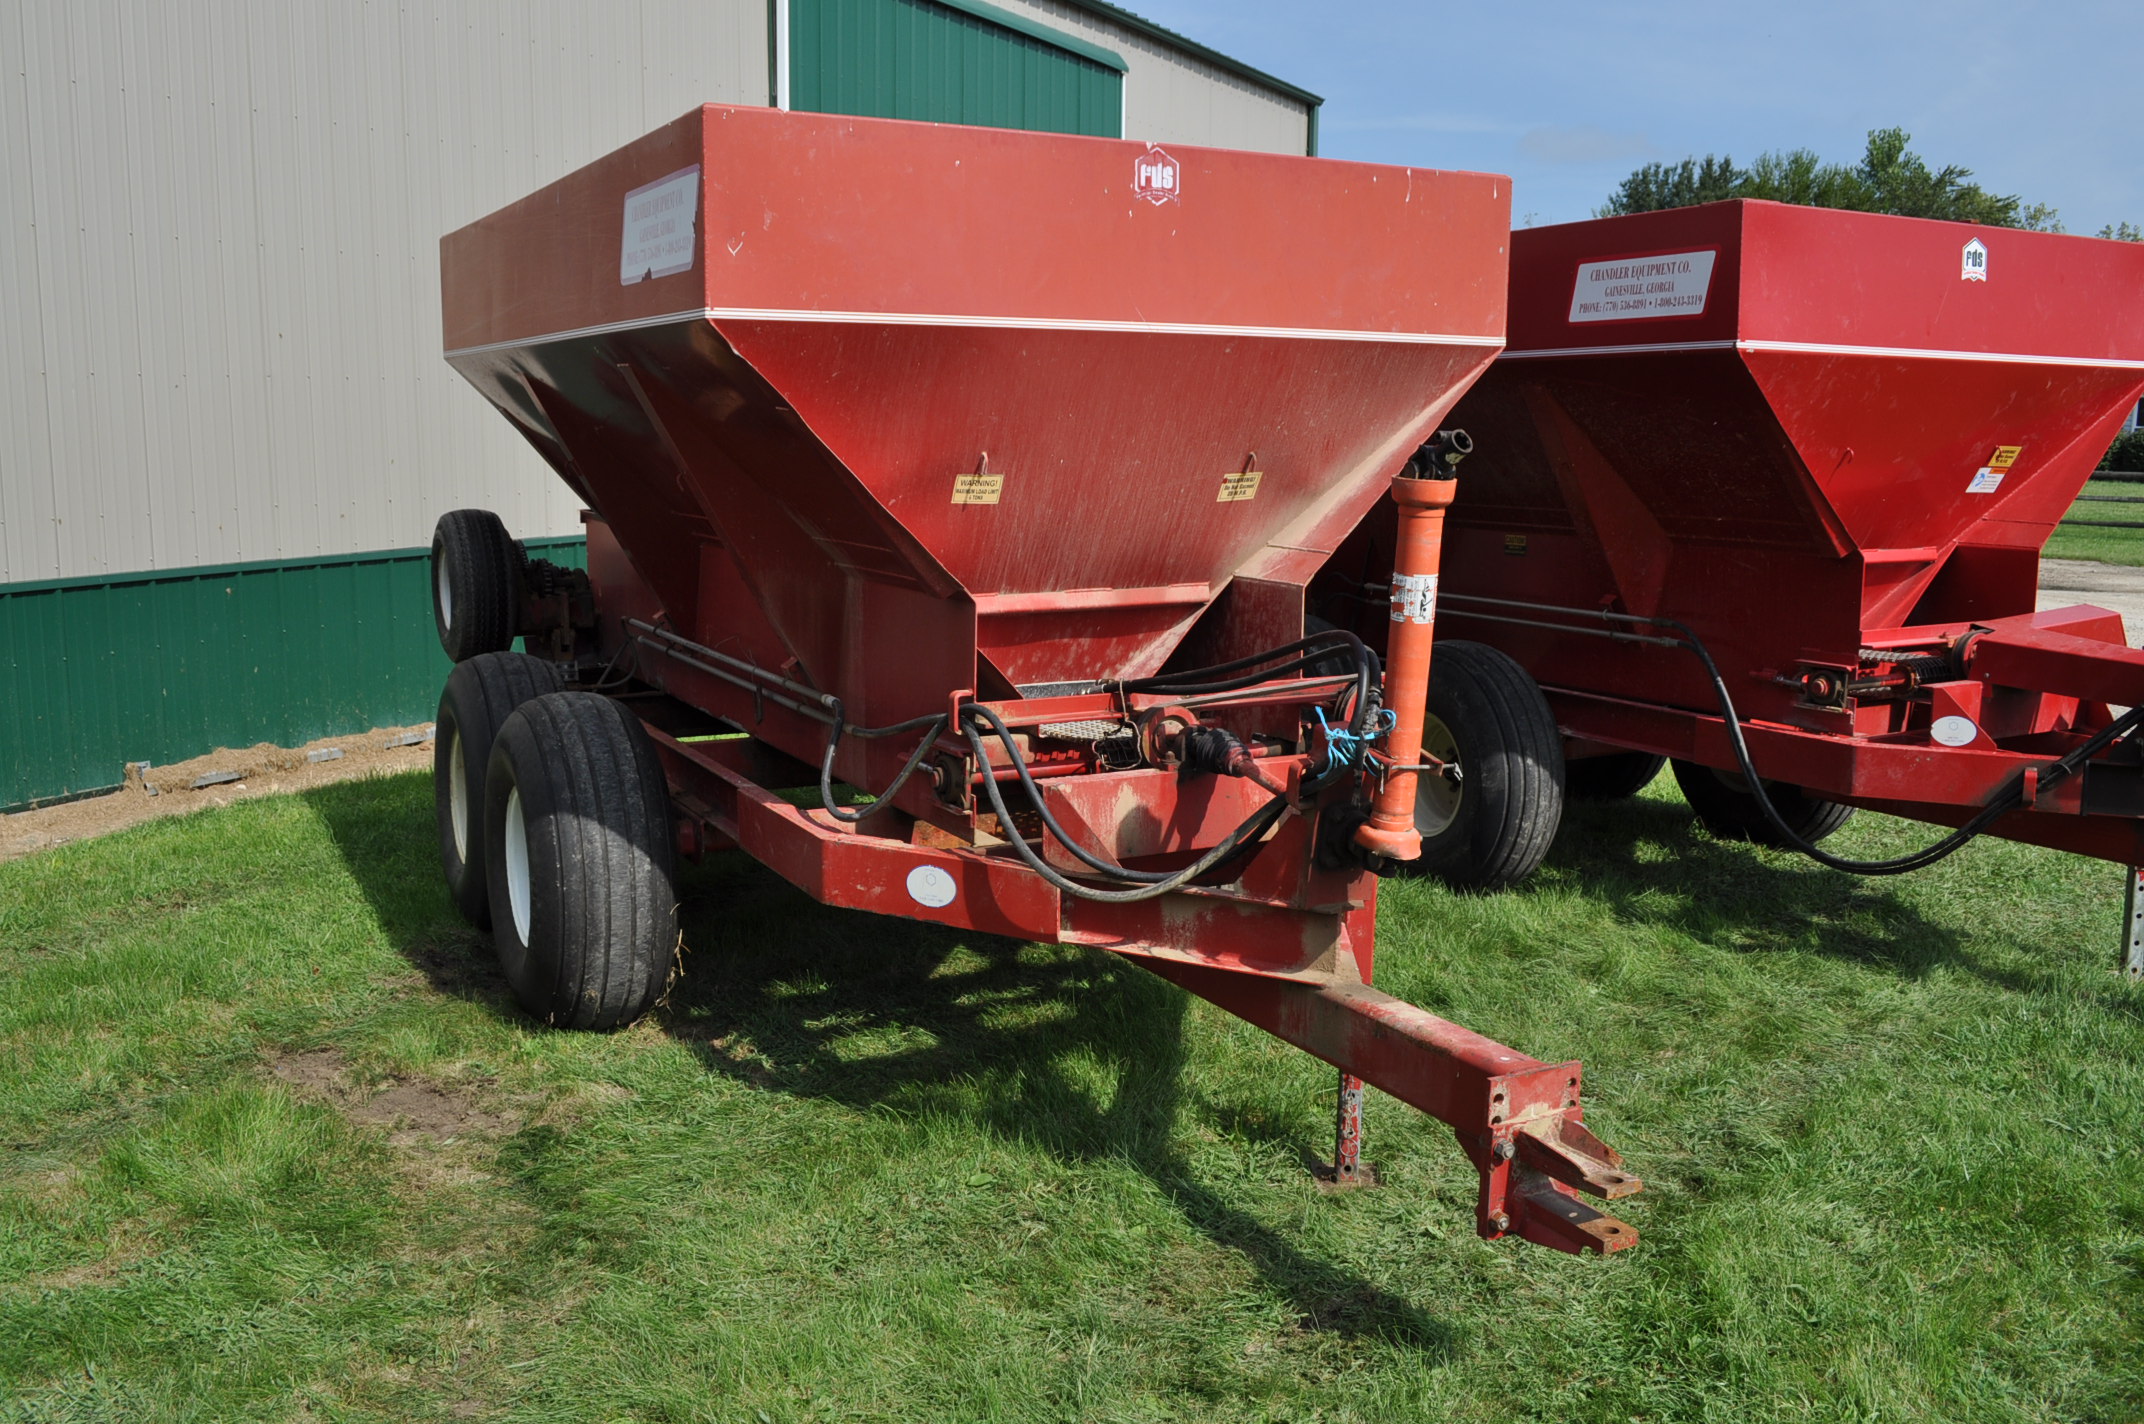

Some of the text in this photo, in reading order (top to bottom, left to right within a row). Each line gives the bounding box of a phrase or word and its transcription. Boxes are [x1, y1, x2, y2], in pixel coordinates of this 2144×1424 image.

[1590, 261, 1692, 282] CHANDLER EQUIPMENT CO.
[1604, 281, 1675, 298] GAINESVILLE, GEORGIA
[1578, 302, 1602, 314] PHONE:
[1602, 301, 1619, 312] (770)
[1619, 298, 1647, 311] 536-8891
[960, 479, 998, 487] WARNING!
